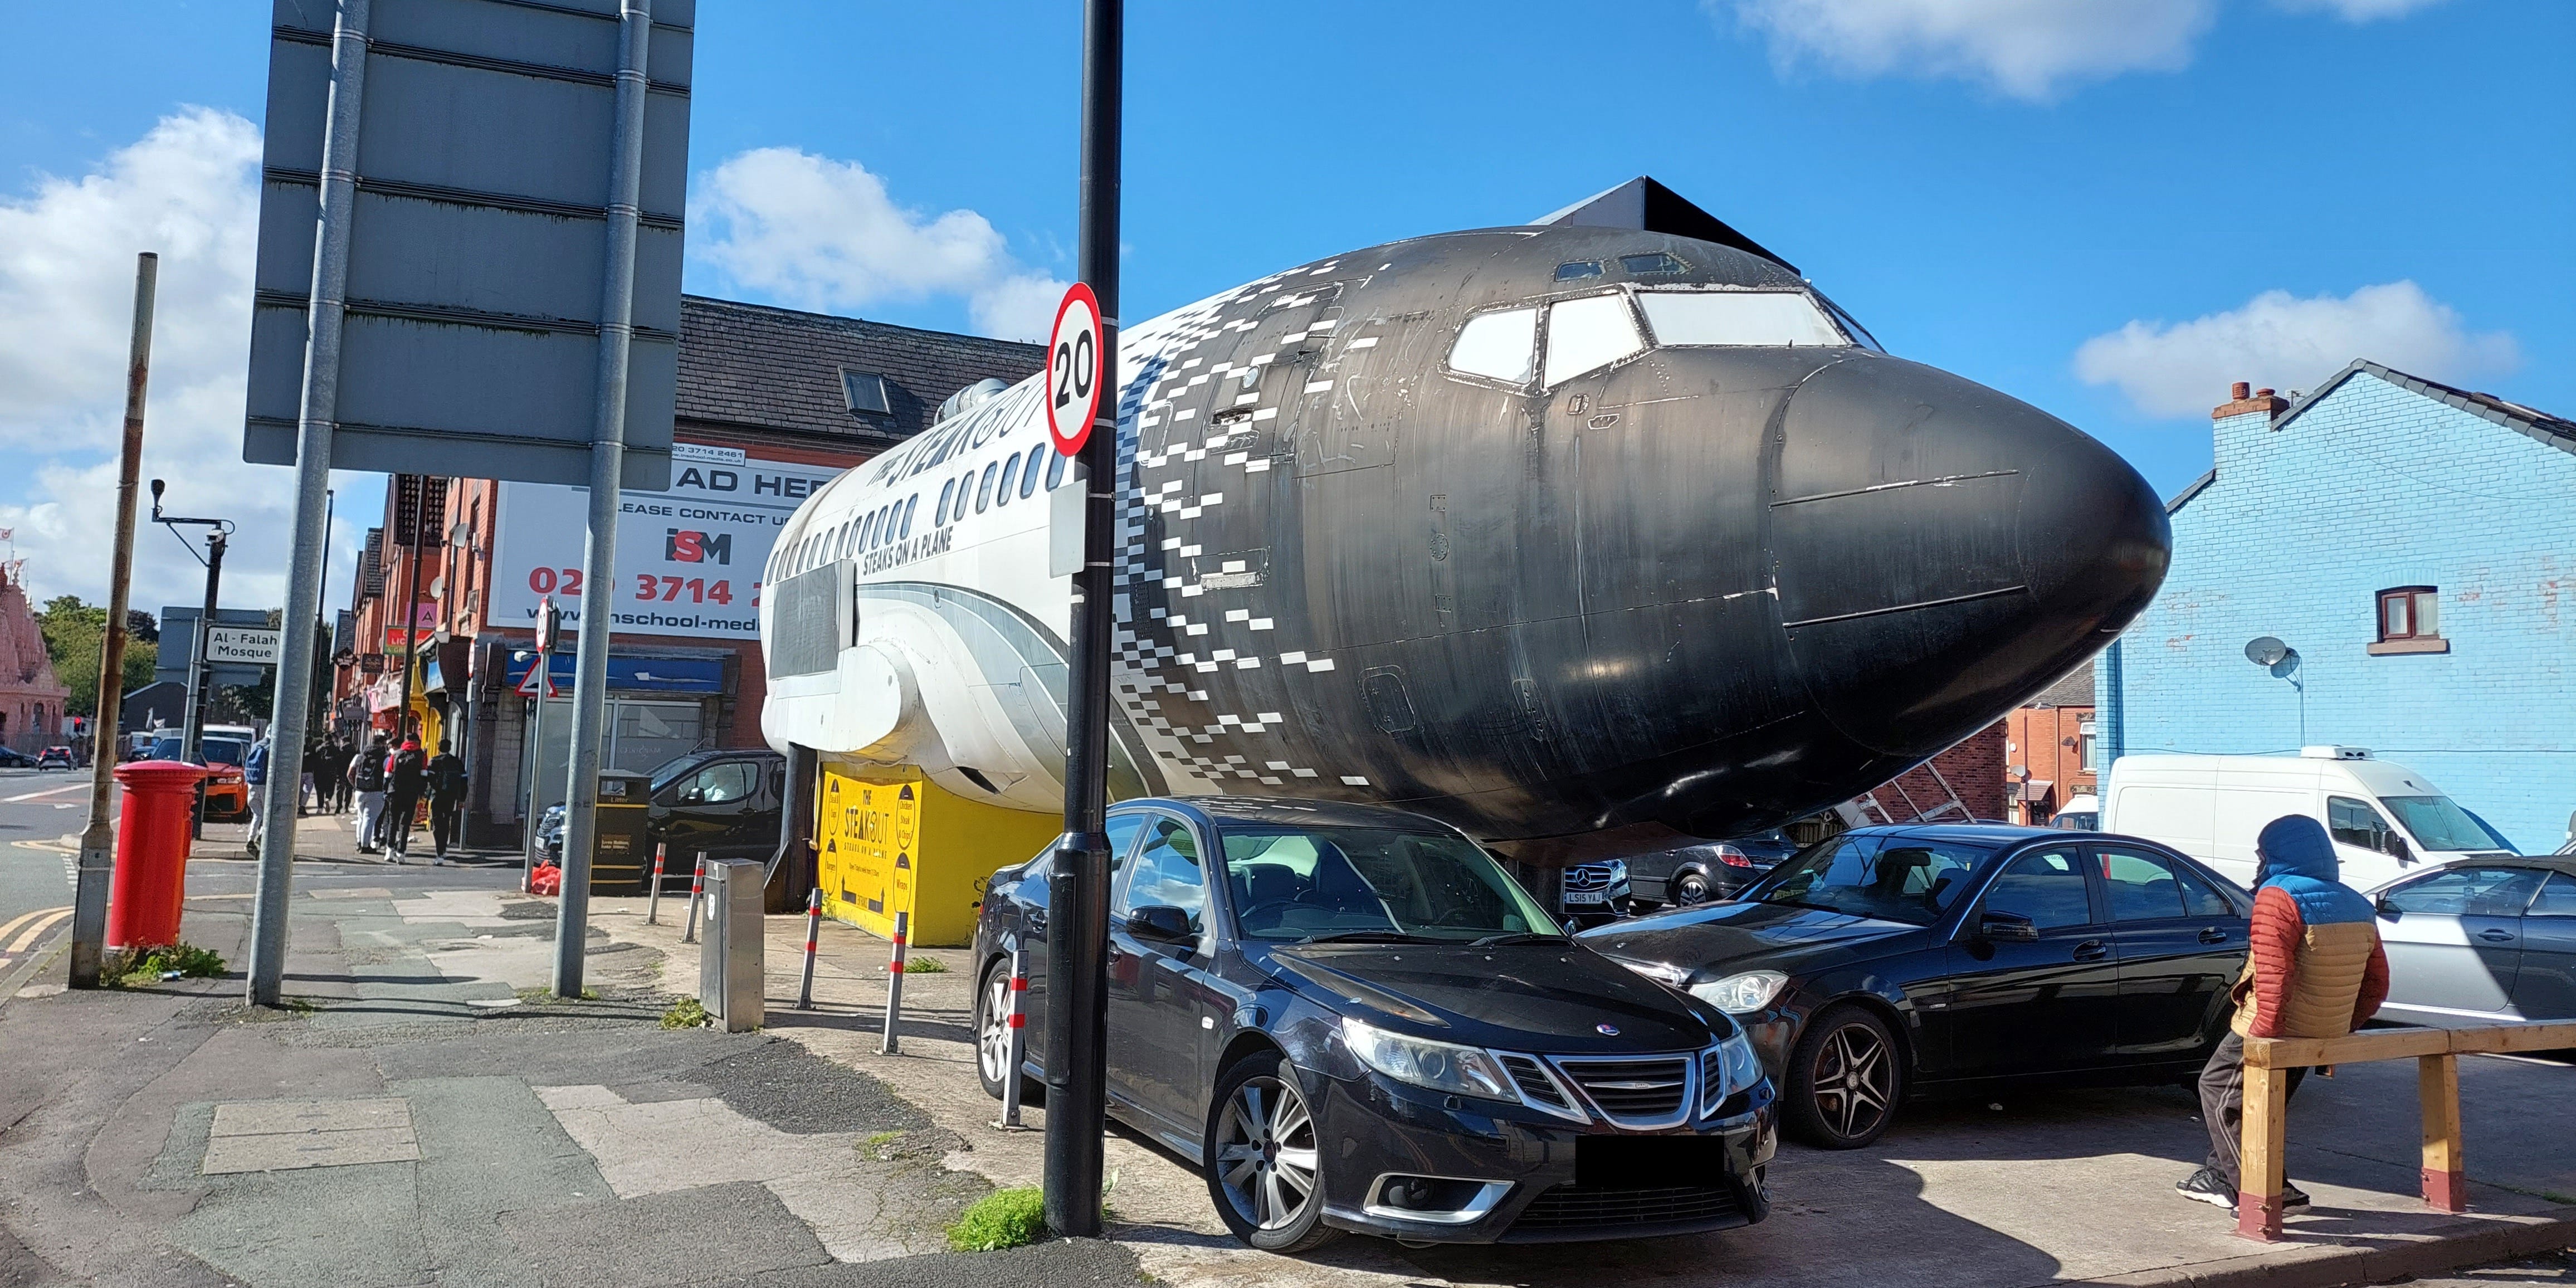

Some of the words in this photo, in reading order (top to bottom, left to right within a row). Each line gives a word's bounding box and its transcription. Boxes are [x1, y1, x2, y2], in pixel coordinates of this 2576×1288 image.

[1055, 329, 1093, 410] 20
[676, 468, 738, 492] AD
[618, 503, 672, 516] EASE
[680, 508, 766, 524] CONTACT
[863, 546, 894, 576] STEAKS
[896, 540, 910, 566] ON
[911, 537, 919, 562] A
[920, 525, 953, 559] PLANE
[529, 567, 615, 595] 02
[636, 574, 733, 605] 3714
[538, 613, 545, 635] 20
[214, 633, 228, 642] Al
[240, 634, 277, 645] Falah
[218, 646, 272, 658] Mosque
[863, 789, 872, 805] THE
[900, 801, 913, 810] Chicken
[845, 807, 889, 845] STEAKOUT
[900, 816, 910, 824] Steak
[844, 842, 860, 853] STEAKS
[861, 846, 867, 855] ON
[896, 879, 908, 892] Wraps
[1569, 894, 1586, 902] LS15
[1588, 894, 1601, 902] YAJ
